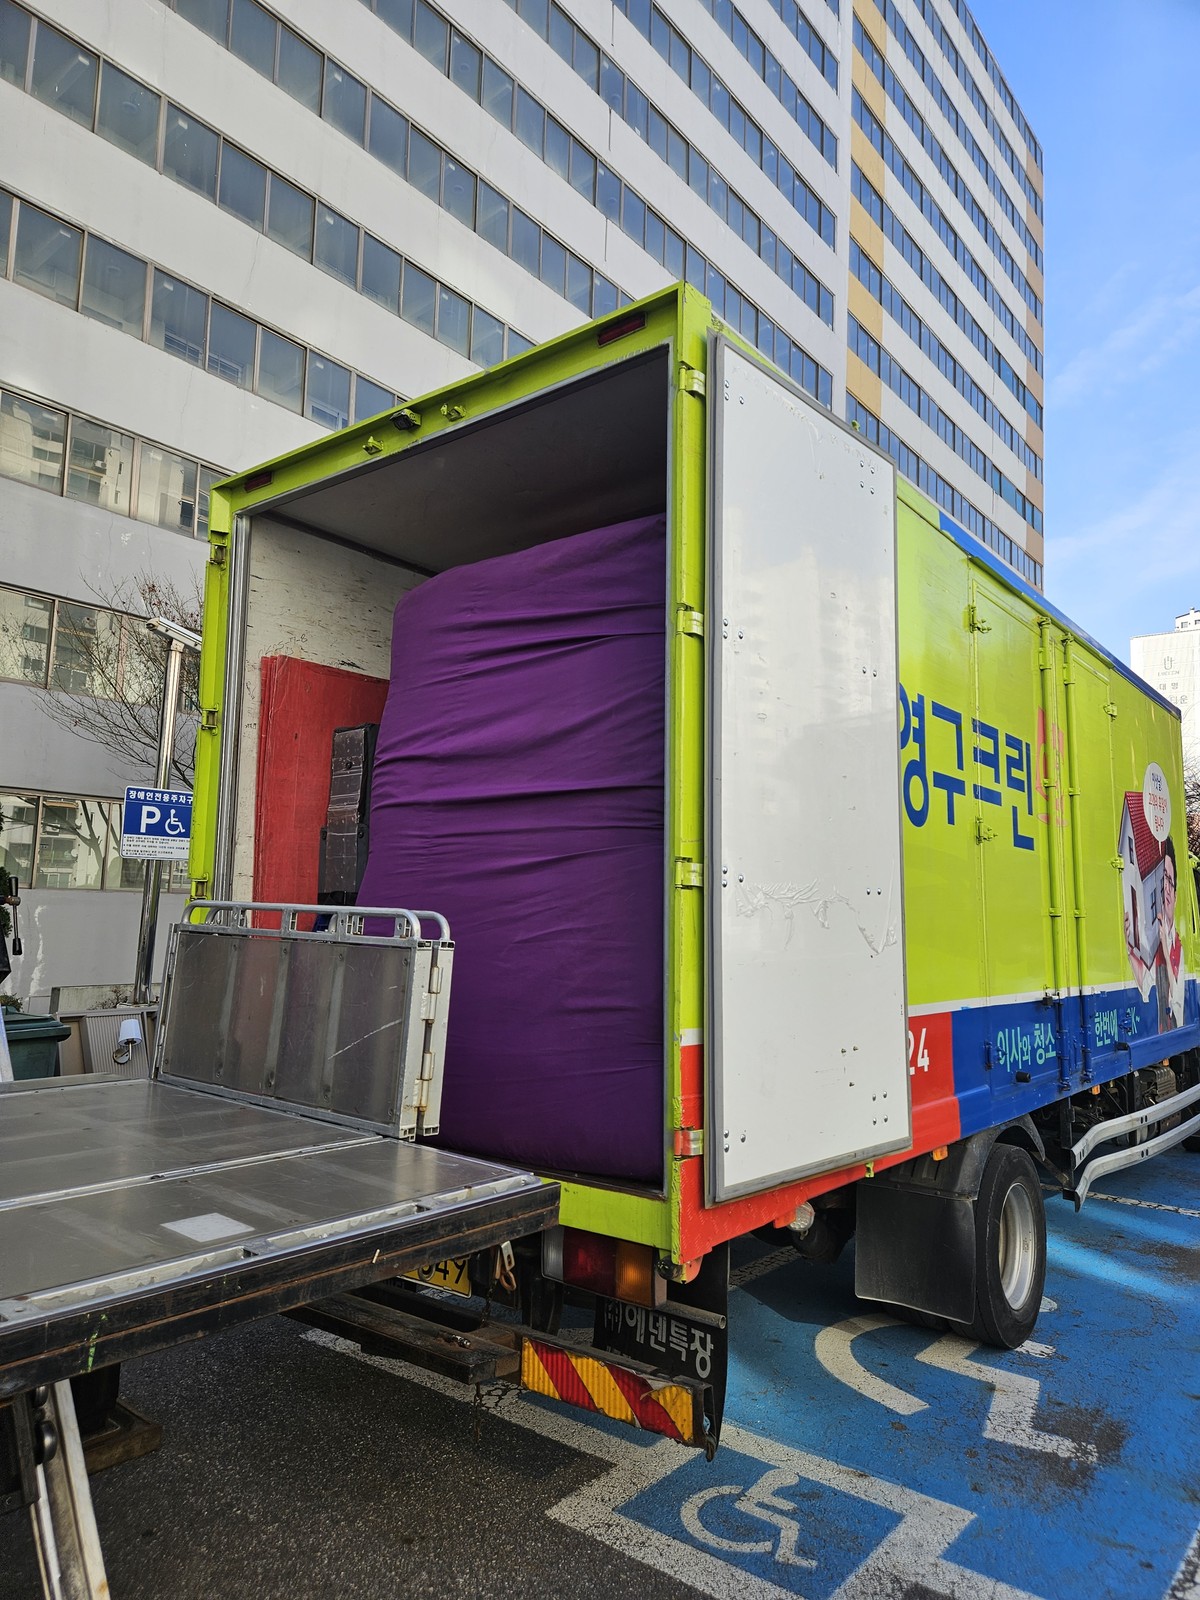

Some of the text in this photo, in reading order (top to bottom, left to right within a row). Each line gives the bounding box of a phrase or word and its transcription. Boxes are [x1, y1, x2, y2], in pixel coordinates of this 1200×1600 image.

[899, 682, 1035, 852] 영구크린
[140, 805, 161, 833] P
[996, 1022, 1057, 1072] 이사와 청소
[1094, 1009, 1119, 1047] 한번에
